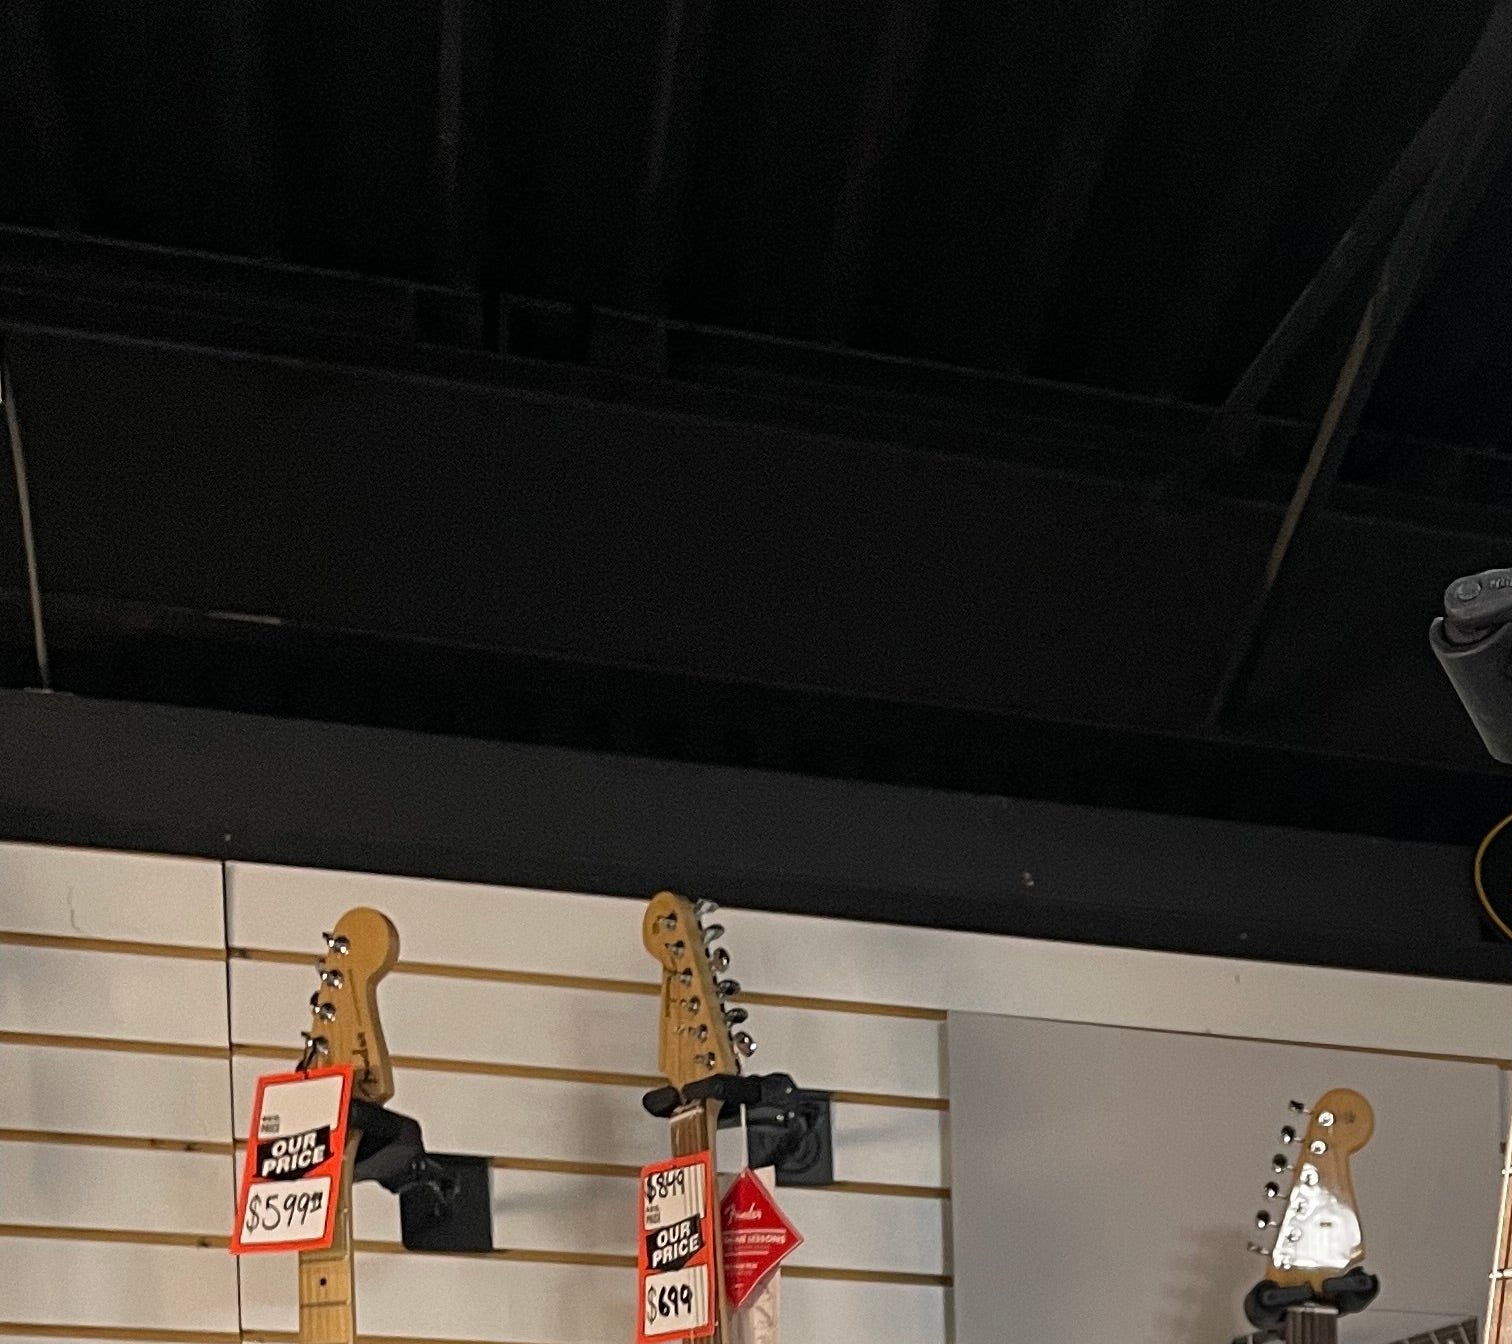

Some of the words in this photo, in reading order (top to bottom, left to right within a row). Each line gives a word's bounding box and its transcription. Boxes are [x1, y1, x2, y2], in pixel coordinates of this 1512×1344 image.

[261, 1144, 327, 1178] PRICE
[271, 1132, 318, 1158] OUR
[651, 1232, 700, 1270] PRICE
[656, 1220, 692, 1249] OUR
[647, 1283, 693, 1325] $699
